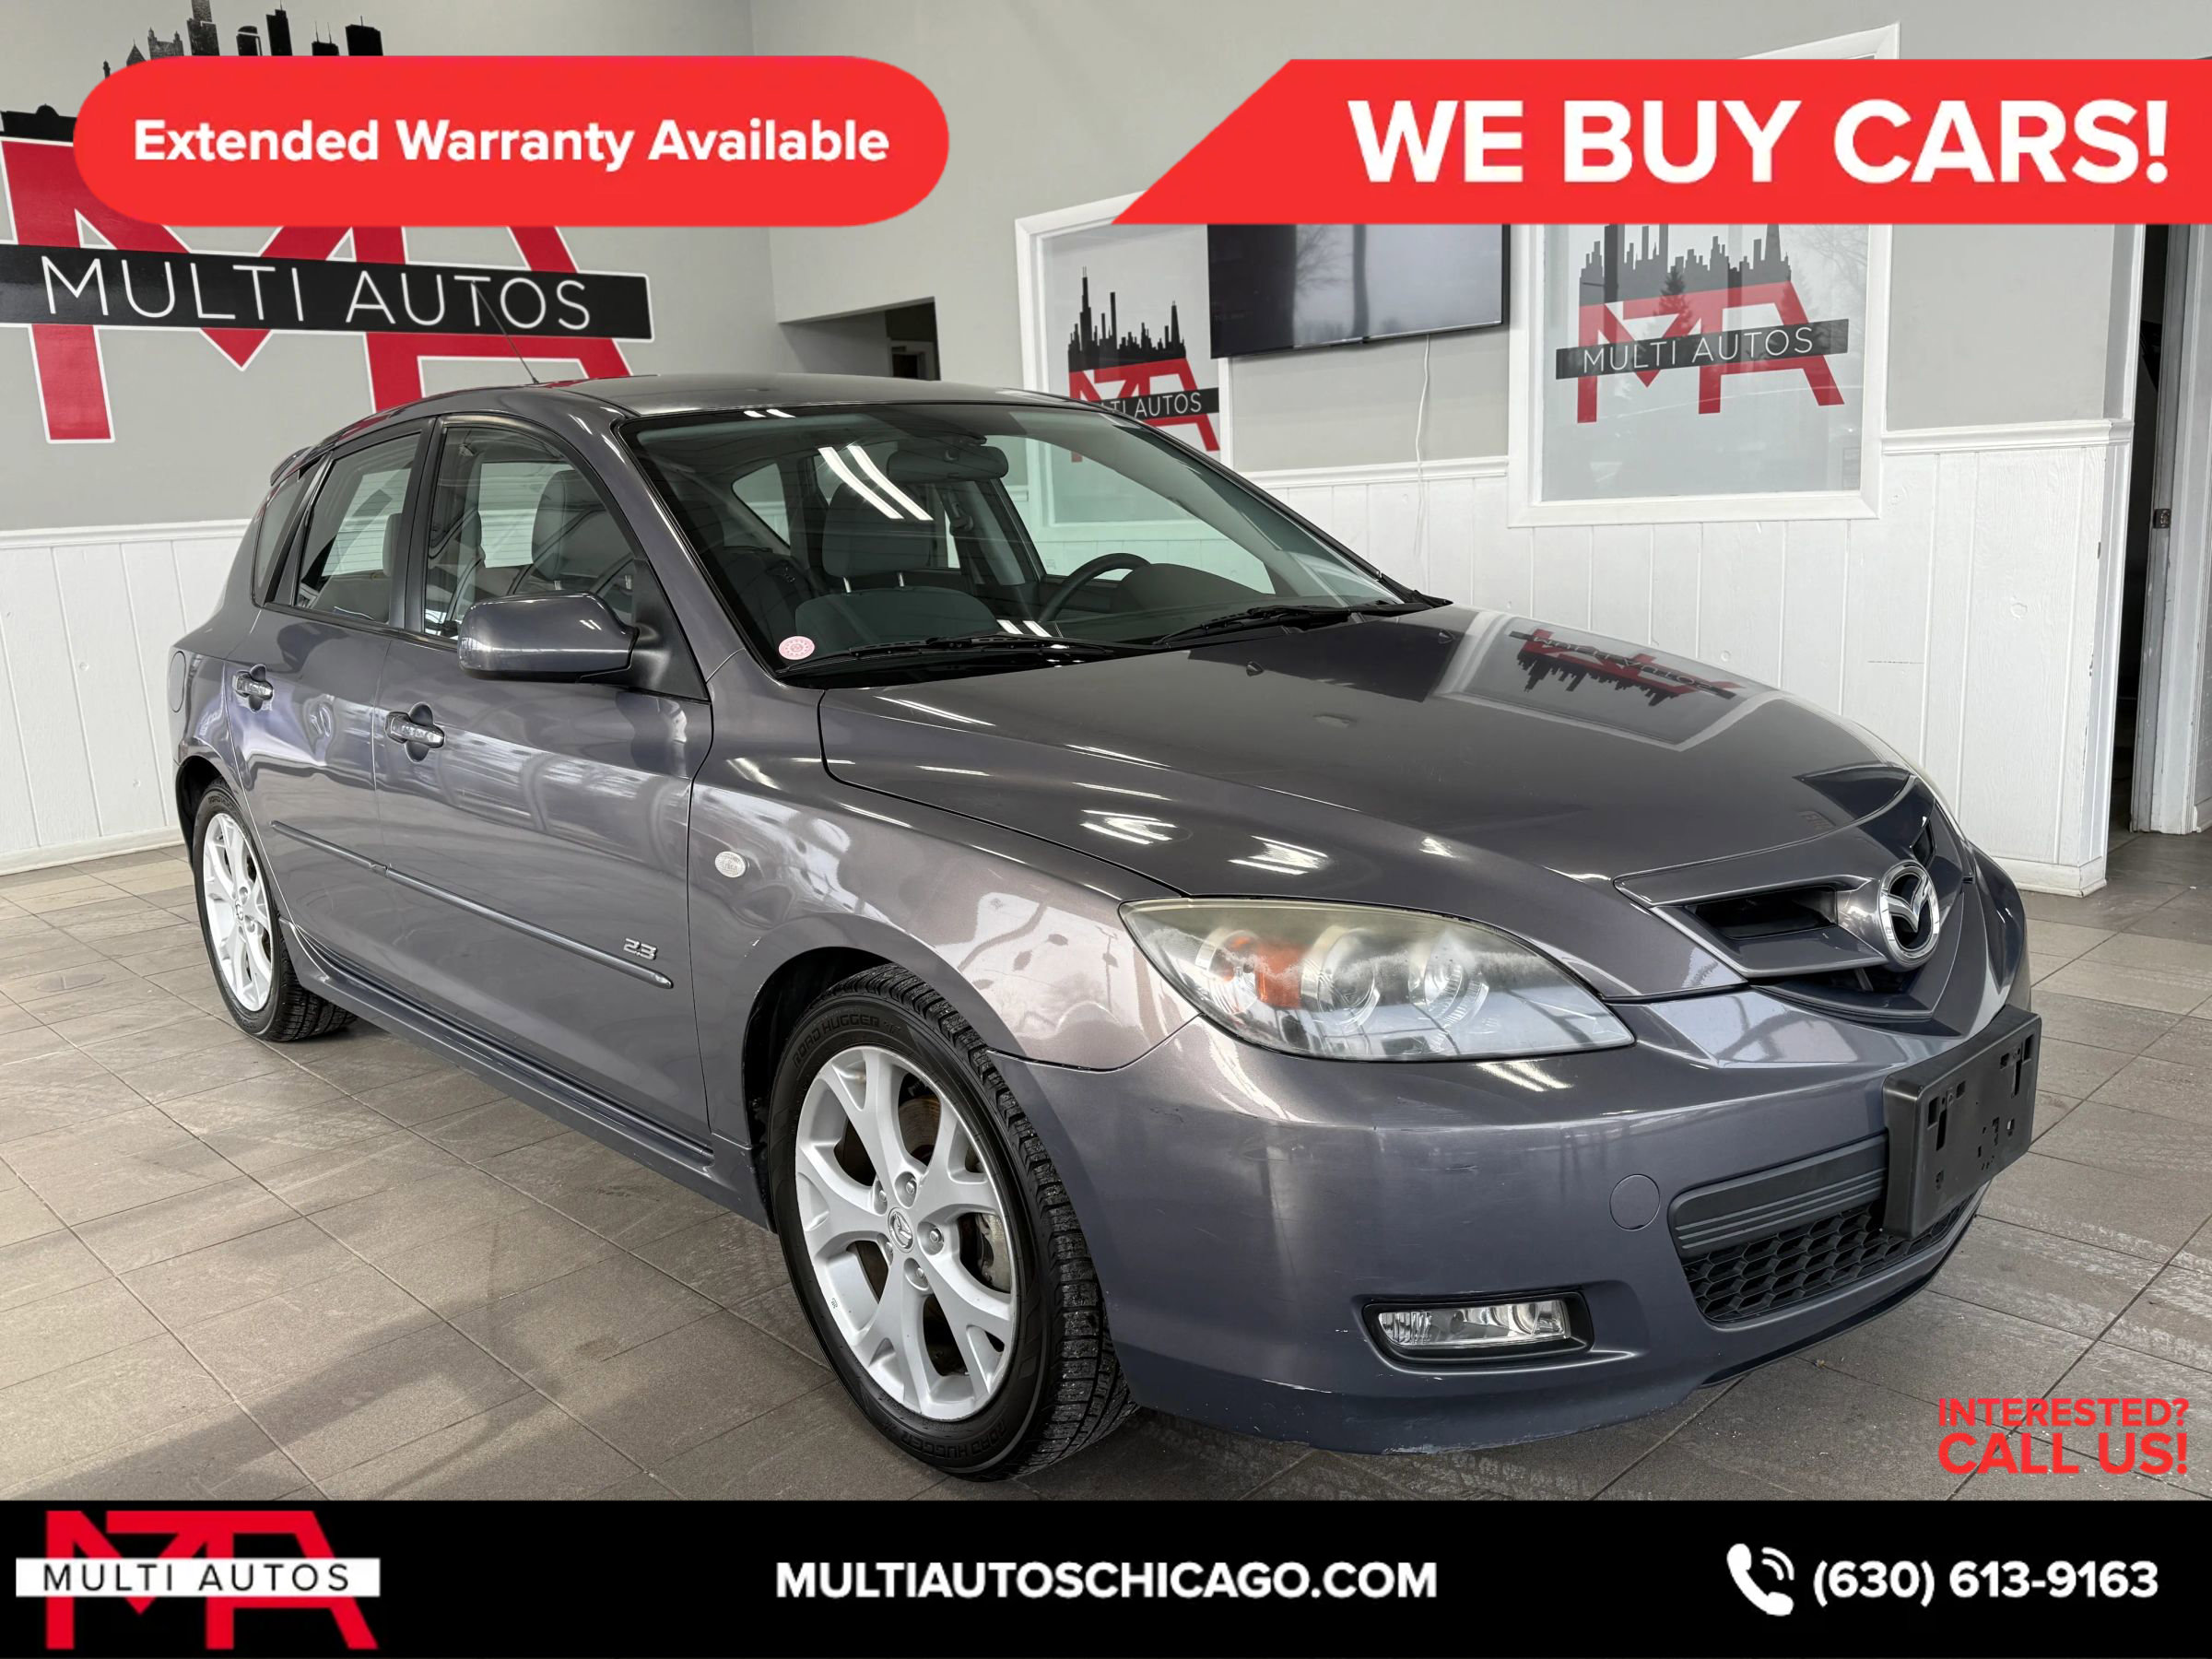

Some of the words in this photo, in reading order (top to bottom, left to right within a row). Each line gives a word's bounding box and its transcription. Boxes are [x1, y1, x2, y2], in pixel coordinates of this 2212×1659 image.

[41, 254, 305, 323] MULTI
[345, 268, 591, 330] AUTOS
[1583, 338, 1677, 373] MULTI
[1691, 326, 1814, 364] AUTOS
[1135, 392, 1202, 418] AUTOS
